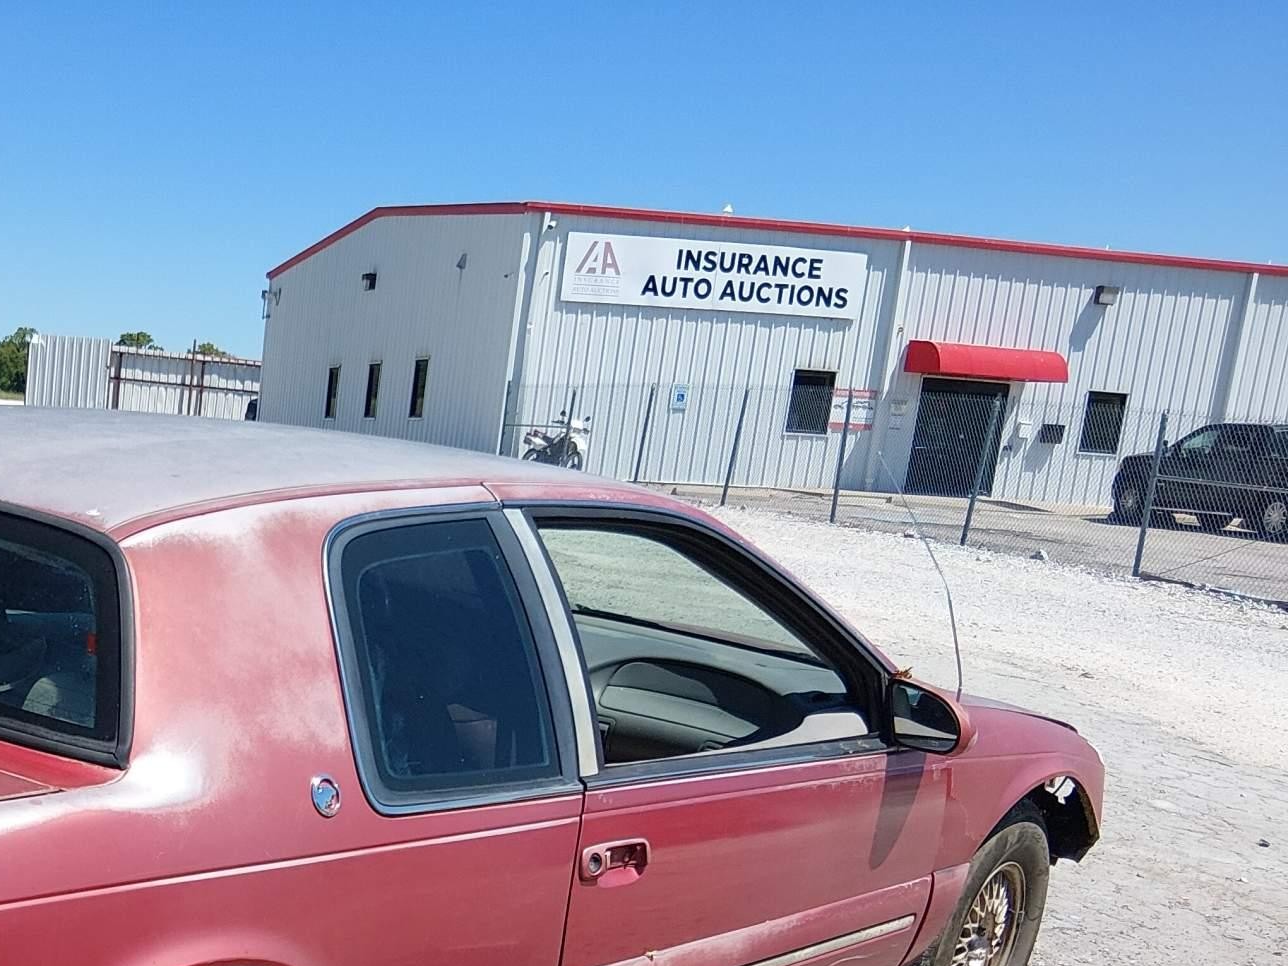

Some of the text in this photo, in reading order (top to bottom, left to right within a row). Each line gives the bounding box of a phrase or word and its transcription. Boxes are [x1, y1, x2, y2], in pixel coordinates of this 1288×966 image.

[676, 248, 824, 280] INSURANCE
[641, 274, 849, 310] AUTO AUCTIONS
